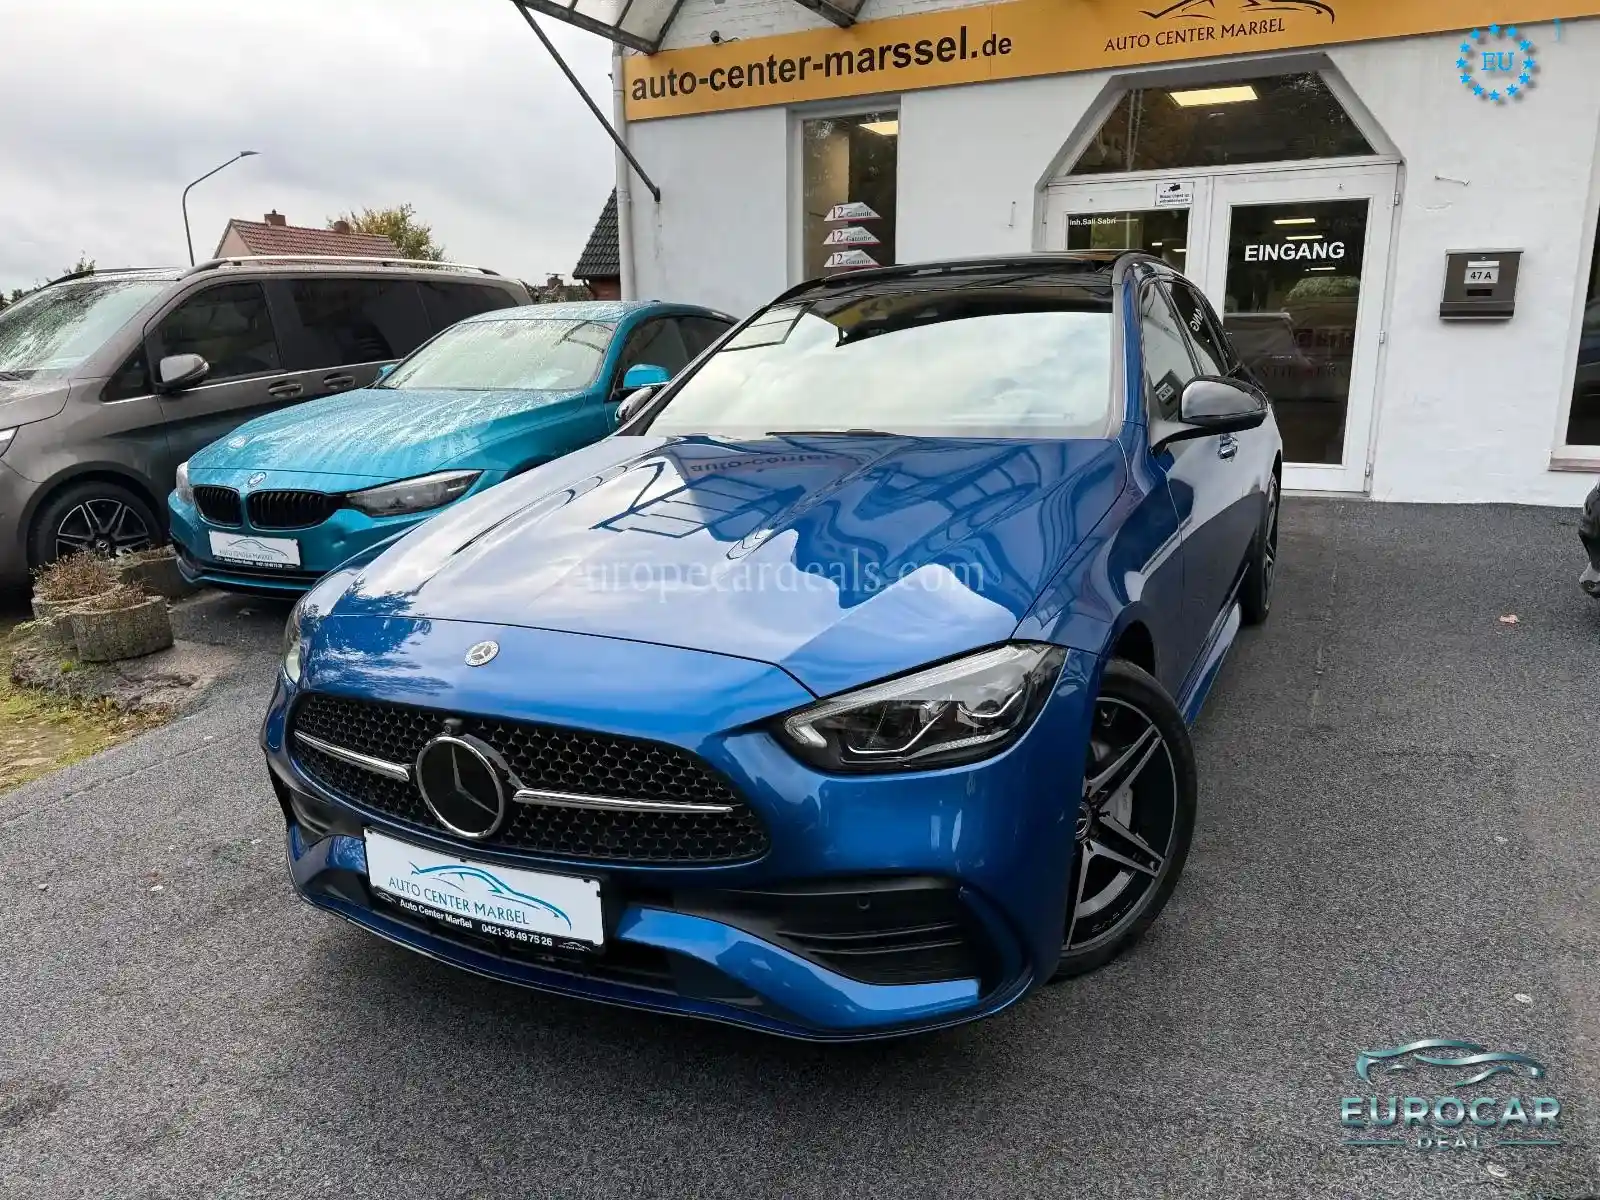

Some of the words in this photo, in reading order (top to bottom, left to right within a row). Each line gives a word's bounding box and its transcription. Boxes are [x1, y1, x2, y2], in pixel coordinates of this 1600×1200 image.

[1104, 34, 1150, 52] AUTO
[1155, 26, 1215, 46] CENTER
[632, 26, 1012, 101] auto-center-marssel.de
[833, 207, 844, 219] 12
[831, 231, 843, 243] 12
[831, 253, 843, 266] 12
[1244, 241, 1345, 262] EINGANG
[1470, 271, 1482, 280] 47
[1484, 271, 1492, 280] A
[389, 876, 421, 897] AUTO
[424, 888, 471, 913] CENTER
[400, 900, 417, 912] Auto
[418, 905, 444, 921] Center
[516, 932, 528, 941] 49
[528, 933, 540, 944] 75
[541, 936, 553, 946] 26
